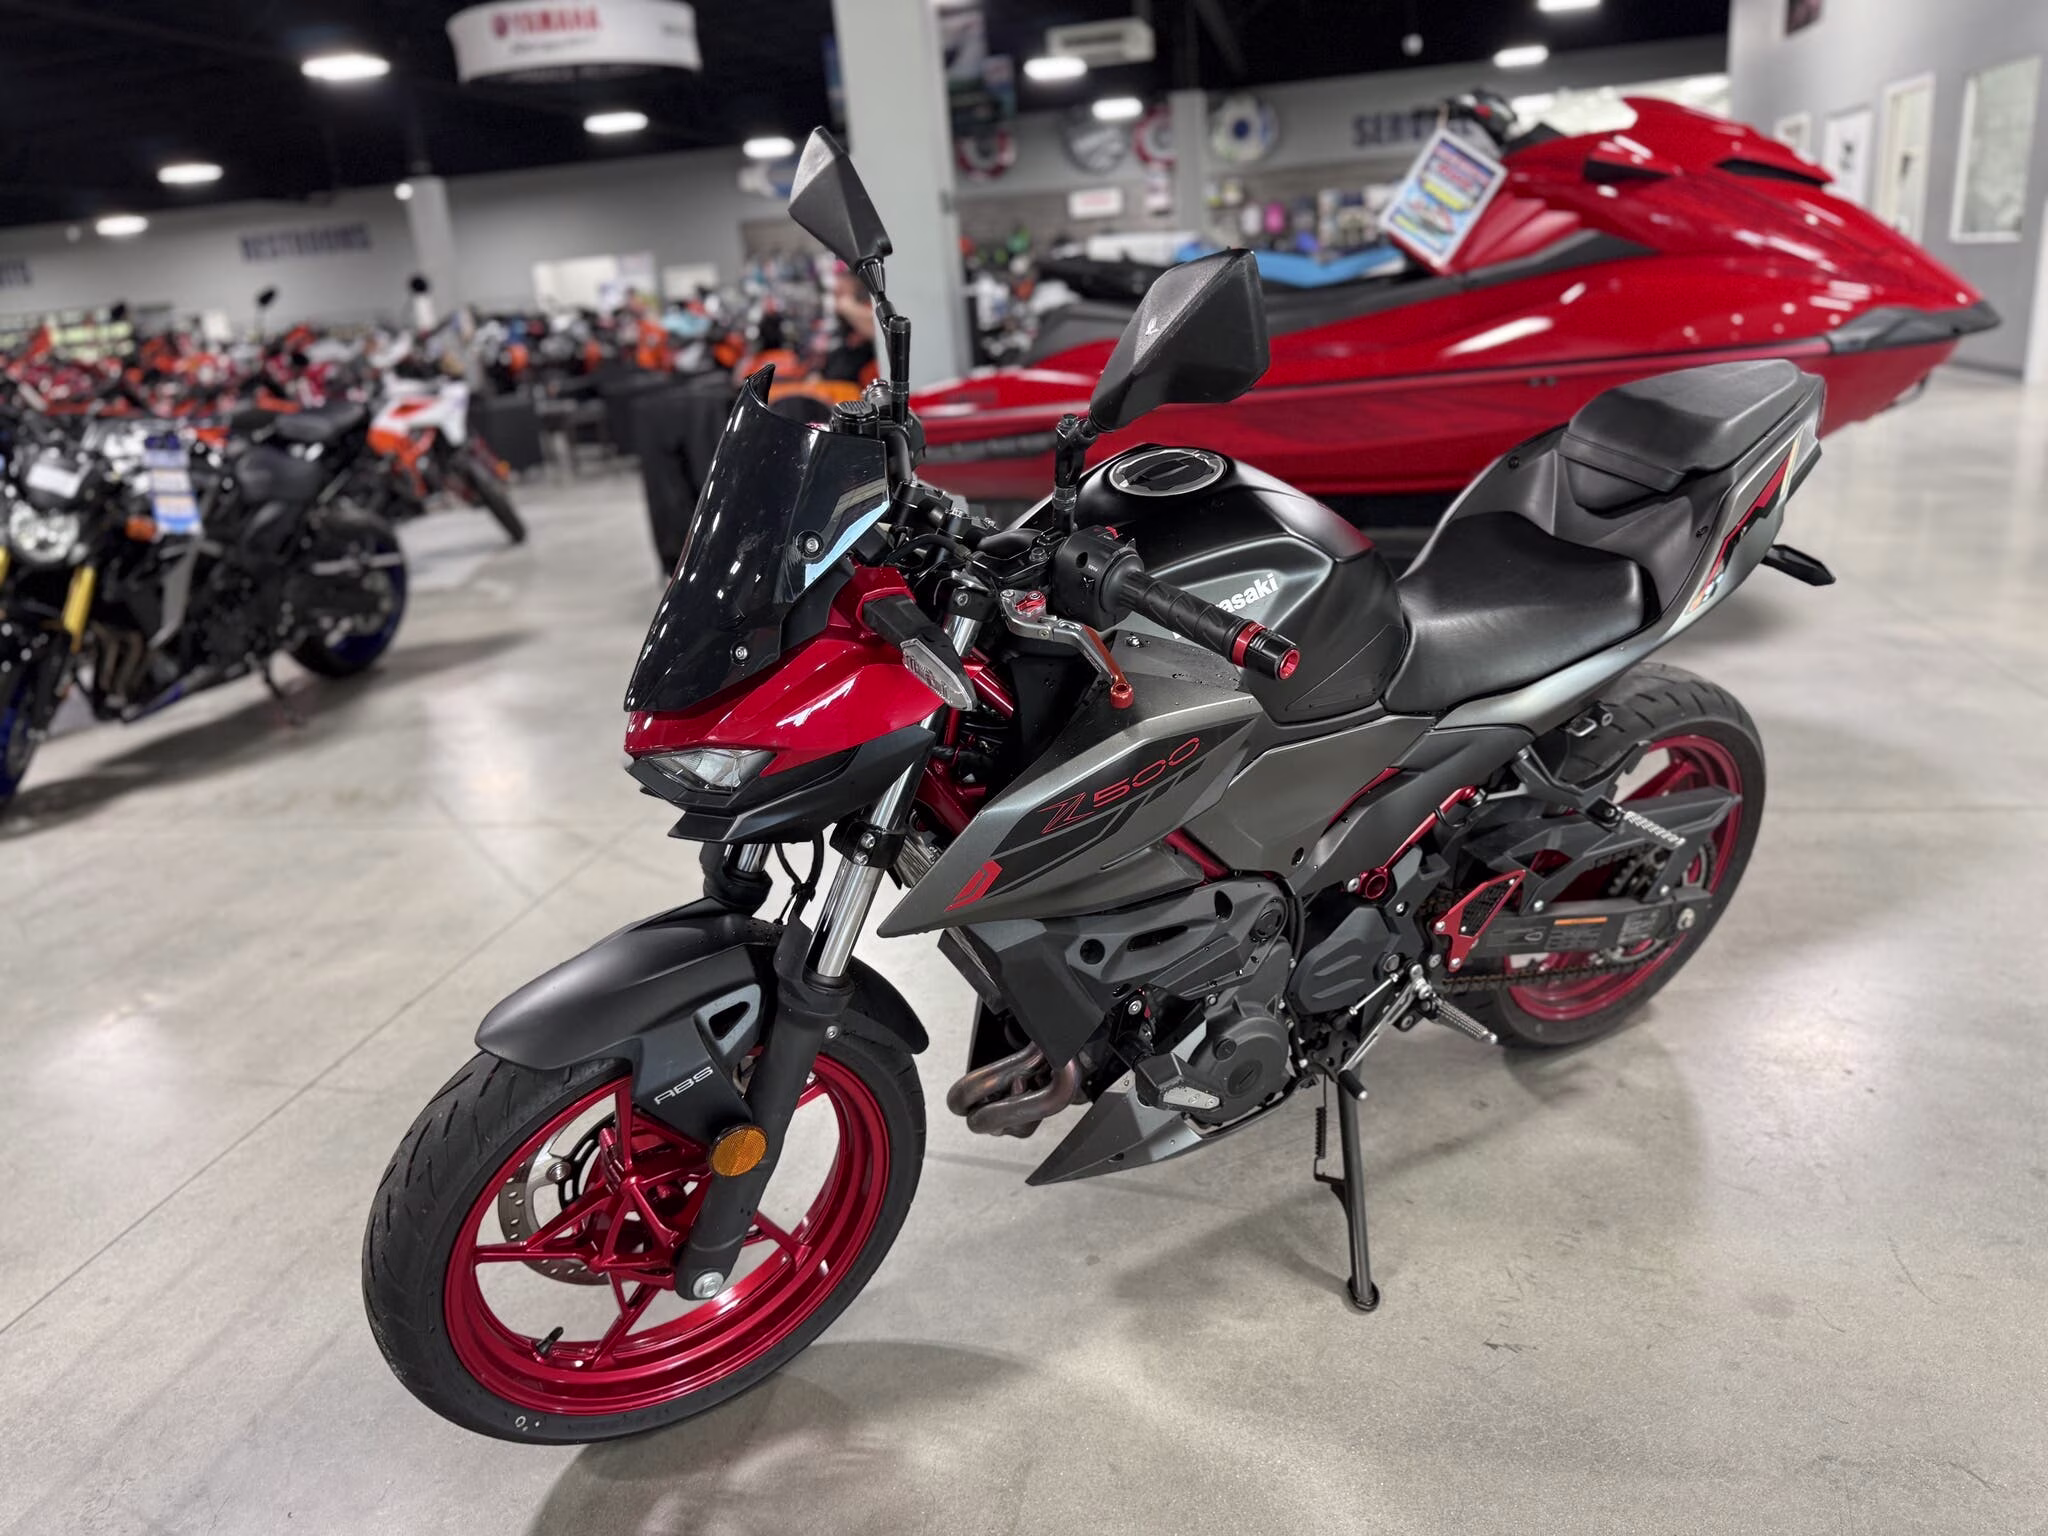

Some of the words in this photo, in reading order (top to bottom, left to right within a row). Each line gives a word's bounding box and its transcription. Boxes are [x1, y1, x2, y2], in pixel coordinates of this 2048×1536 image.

[1215, 572, 1279, 613] asaki
[1038, 737, 1200, 835] Z500
[654, 1066, 714, 1105] ABS
